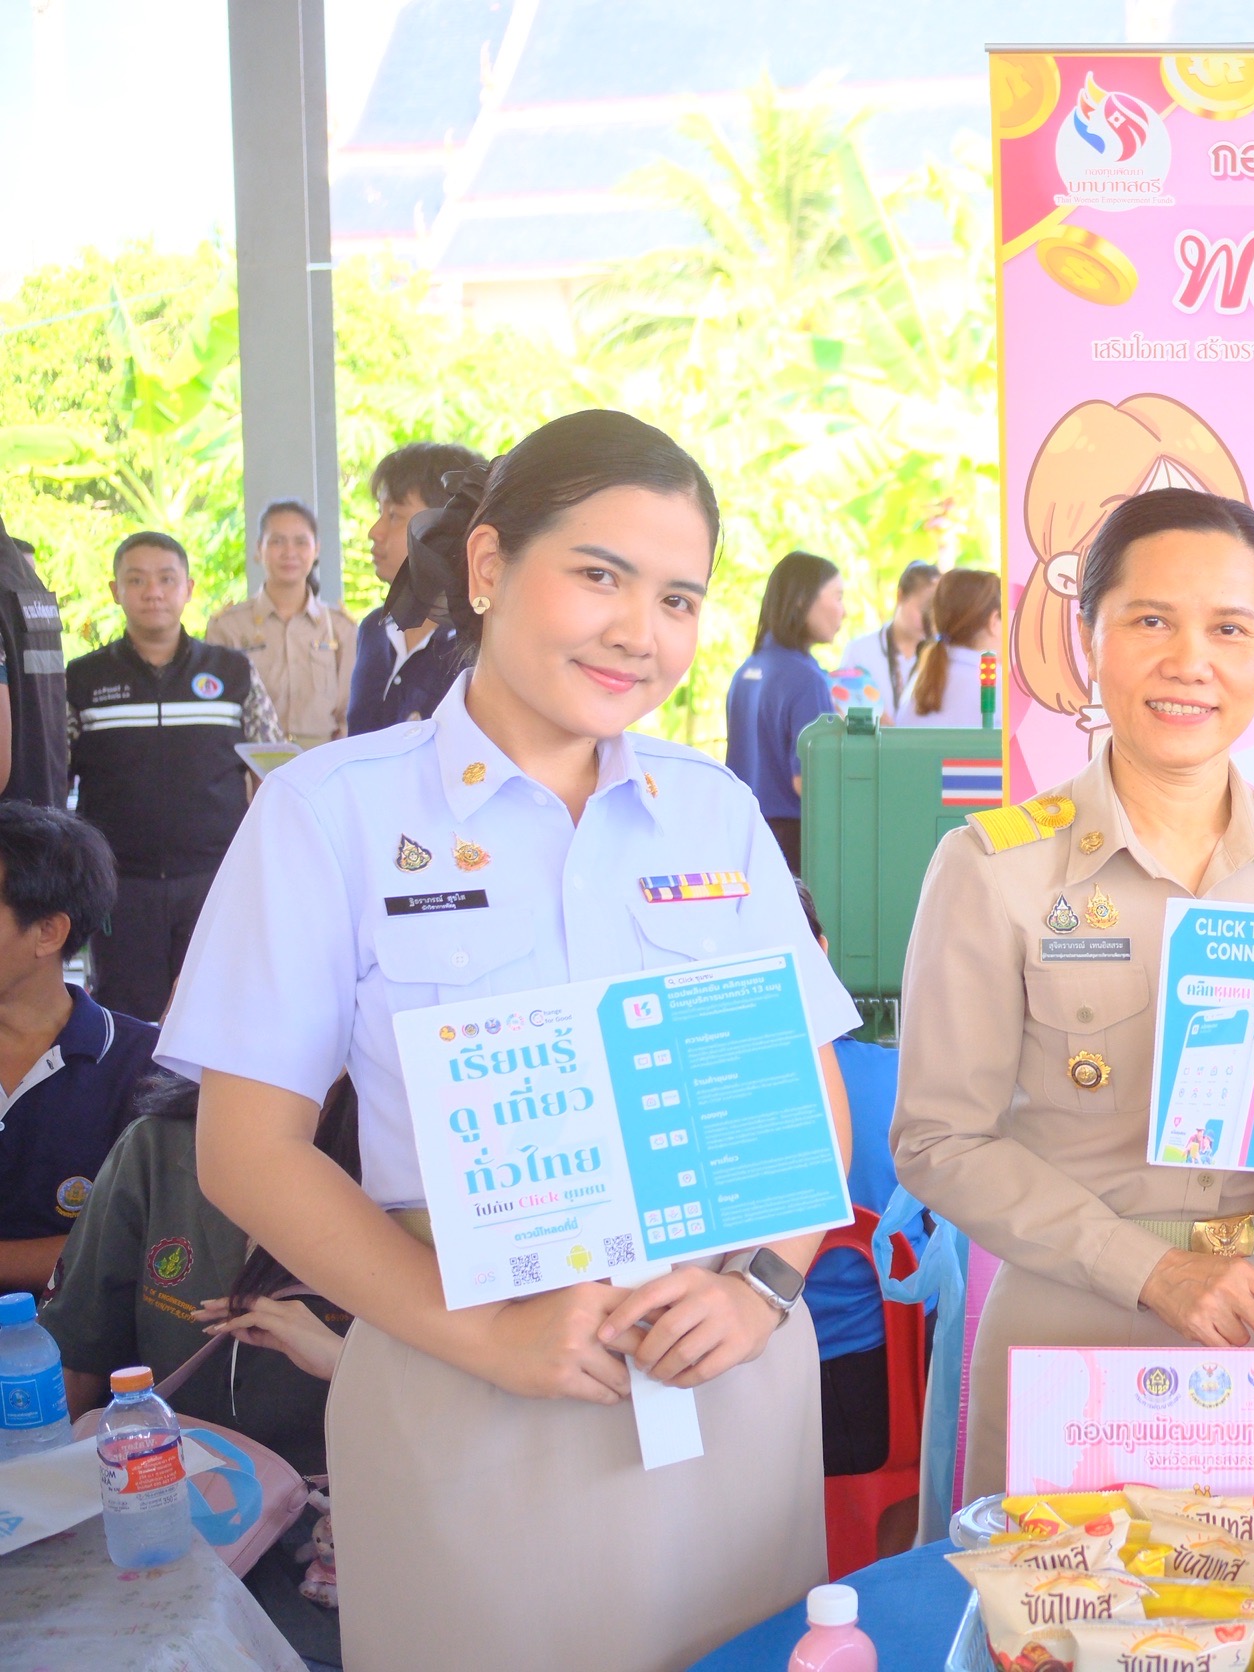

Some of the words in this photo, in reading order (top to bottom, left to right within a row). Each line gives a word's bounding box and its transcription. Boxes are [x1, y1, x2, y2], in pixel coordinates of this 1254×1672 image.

[1069, 178, 1161, 193] บทบาทสตรี
[1074, 195, 1100, 204] Women
[1101, 195, 1151, 206] Empowerment
[1152, 196, 1173, 204] Funds
[1093, 334, 1188, 360] เสริมโอกาส
[1195, 917, 1247, 938] CLICK
[752, 986, 764, 994] 13
[555, 1013, 573, 1023] Good
[449, 1027, 577, 1083] เรียนรู้
[449, 1107, 480, 1143] ดู
[492, 1076, 595, 1126] เที่ยว
[464, 1144, 602, 1196] ทั่วไทย
[475, 1200, 514, 1217] ไปกับ
[518, 1191, 560, 1209] Click
[563, 1184, 607, 1202] ชุมชน
[514, 1216, 579, 1242] ดาวน์โหลดที่นี่
[473, 1270, 497, 1286] iOS
[158, 1292, 197, 1312] ENGINEERING
